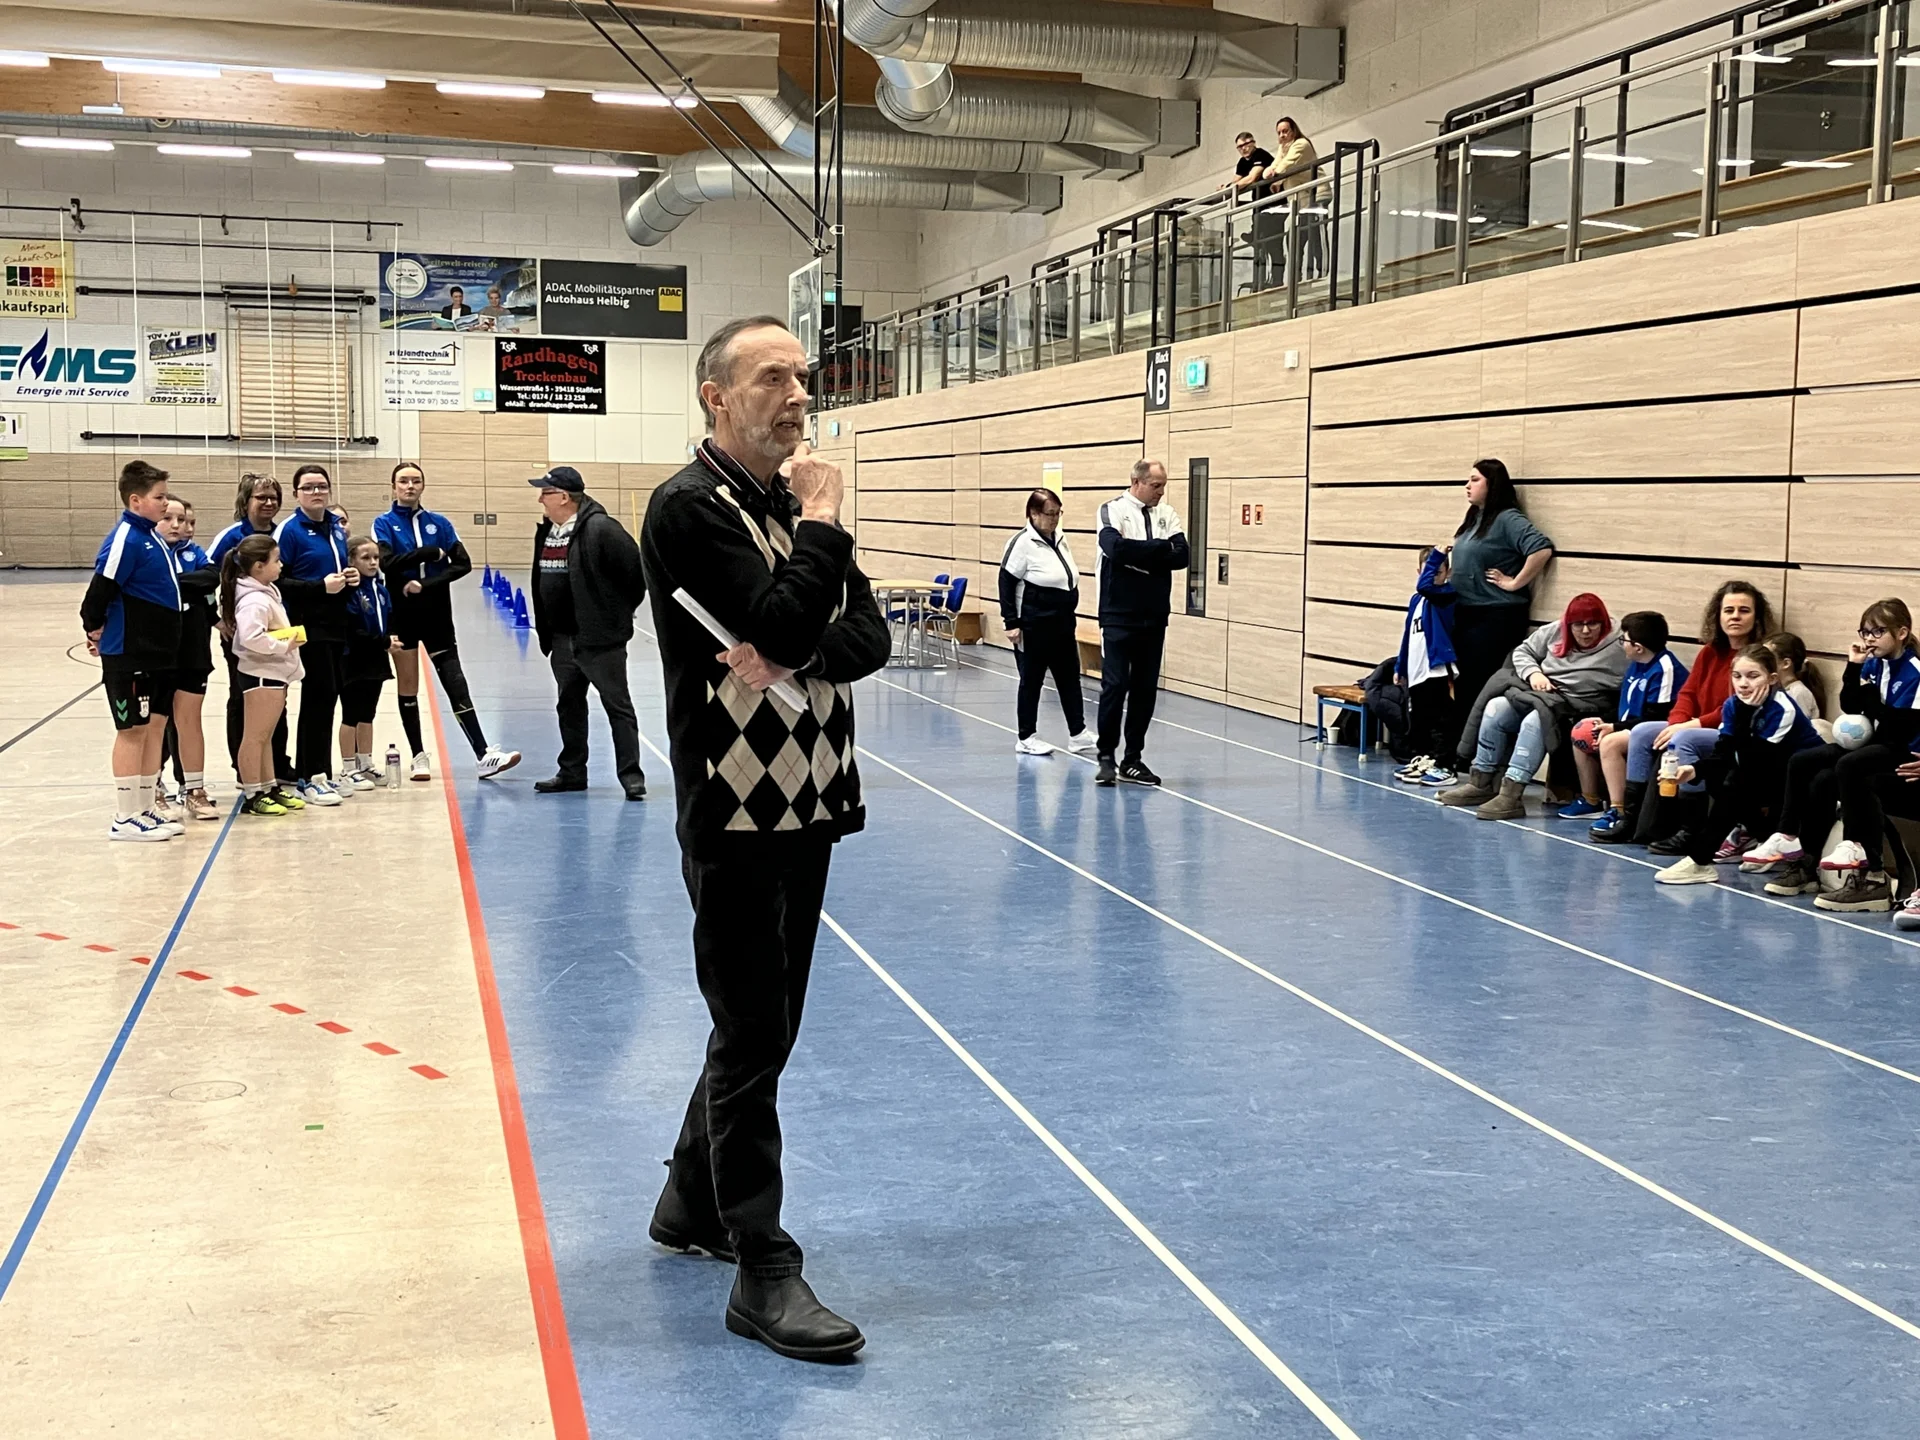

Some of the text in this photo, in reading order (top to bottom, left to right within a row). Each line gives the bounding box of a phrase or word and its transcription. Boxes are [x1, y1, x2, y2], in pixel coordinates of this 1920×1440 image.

[545, 283, 655, 297] ADAC Mobilitätspartner
[660, 288, 682, 297] ADAC
[0, 300, 69, 315] kaufspark
[545, 295, 630, 309] Autohaus Helbig
[166, 332, 217, 351] KLEIN
[501, 347, 598, 375] Randhagen
[1155, 350, 1169, 364] Block
[513, 370, 587, 383] Trockenbau
[16, 386, 130, 397] Energie mit Service
[500, 384, 544, 392] Wasserstraße
[1156, 368, 1167, 405] B
